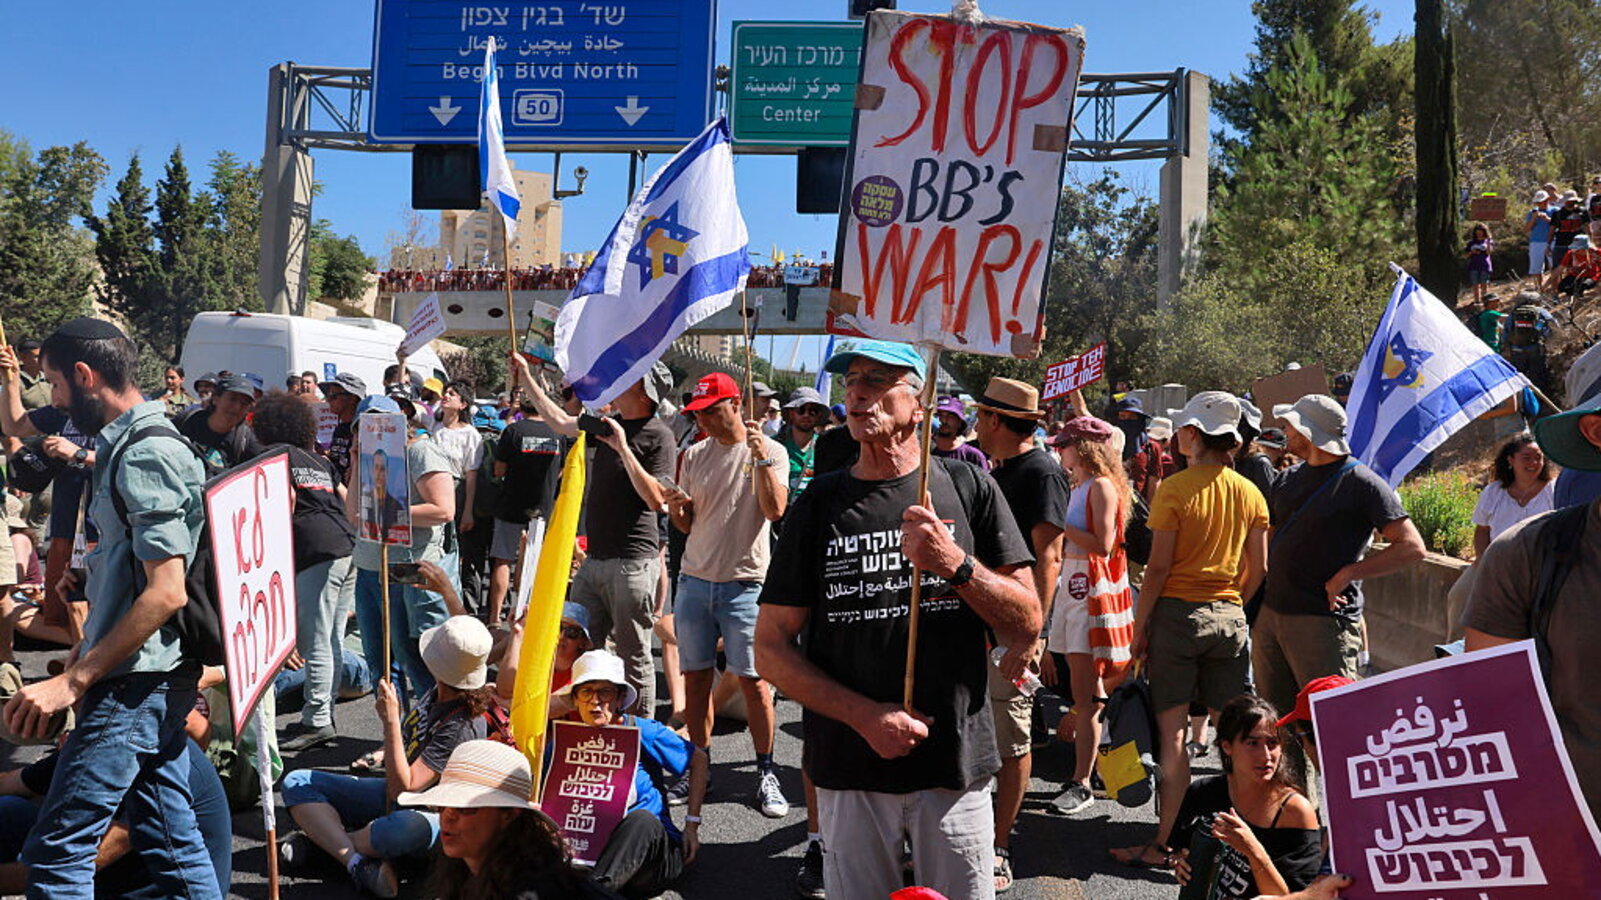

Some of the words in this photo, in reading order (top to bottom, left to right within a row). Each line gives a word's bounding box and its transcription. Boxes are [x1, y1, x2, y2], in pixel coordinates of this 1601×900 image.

[461, 7, 510, 32] צפון
[522, 6, 565, 31] בגין
[584, 35, 624, 54] جادة
[744, 45, 786, 66] העיר
[797, 45, 844, 66] מרכז
[443, 62, 504, 83] Begn
[515, 62, 563, 79] Blvd
[574, 62, 638, 79] North
[744, 76, 796, 96] المدينة
[803, 77, 841, 99] مركز
[873, 18, 1068, 167] STOP
[525, 100, 551, 115] 50
[763, 106, 821, 122] Center
[858, 223, 1043, 347] WAR!
[1046, 360, 1079, 383] STOP
[231, 466, 268, 577] לא
[865, 583, 883, 597] مع
[864, 604, 909, 620] לכיבוש
[919, 599, 960, 612] מסתכלי
[1366, 696, 1469, 756] نرفض
[577, 735, 616, 753] نرفض
[569, 751, 621, 766] מסרבים
[1355, 741, 1504, 790] מסרבים
[567, 766, 614, 783] احتلال
[562, 782, 611, 798] לכיבוש
[571, 799, 594, 818] غزة
[567, 818, 594, 831] עזה
[1374, 789, 1507, 850] احتلال
[1374, 838, 1526, 885] לכיבוש
